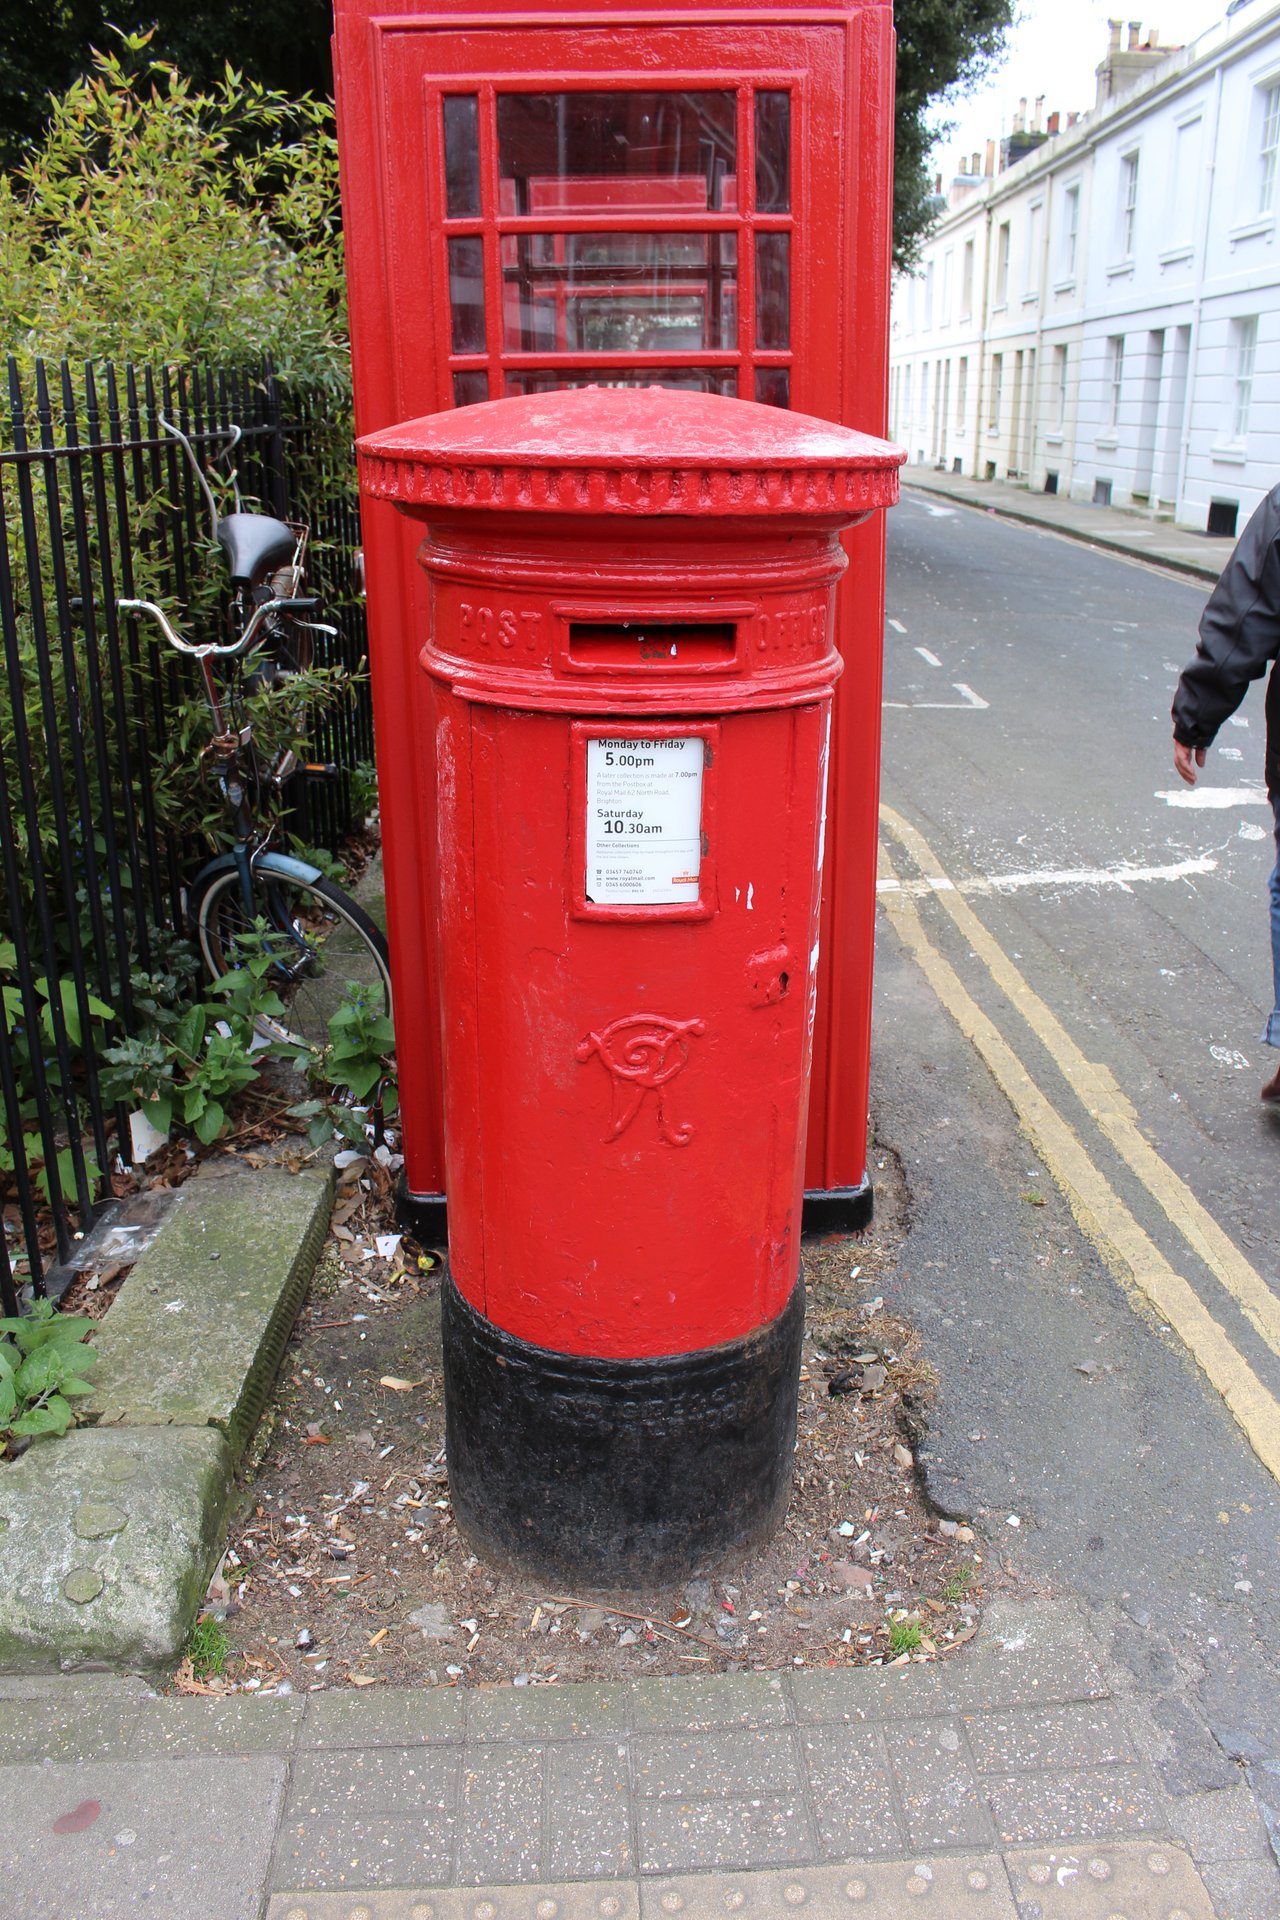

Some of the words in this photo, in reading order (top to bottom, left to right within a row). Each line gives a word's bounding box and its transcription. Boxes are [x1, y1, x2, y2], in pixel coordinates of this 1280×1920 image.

[598, 740, 638, 750] Monday
[641, 740, 651, 749] to
[653, 739, 685, 750] Friday
[605, 752, 655, 768] 5.00pm
[597, 797, 622, 805] Brighton
[597, 808, 644, 819] Saturday
[604, 820, 663, 834] 10.30am
